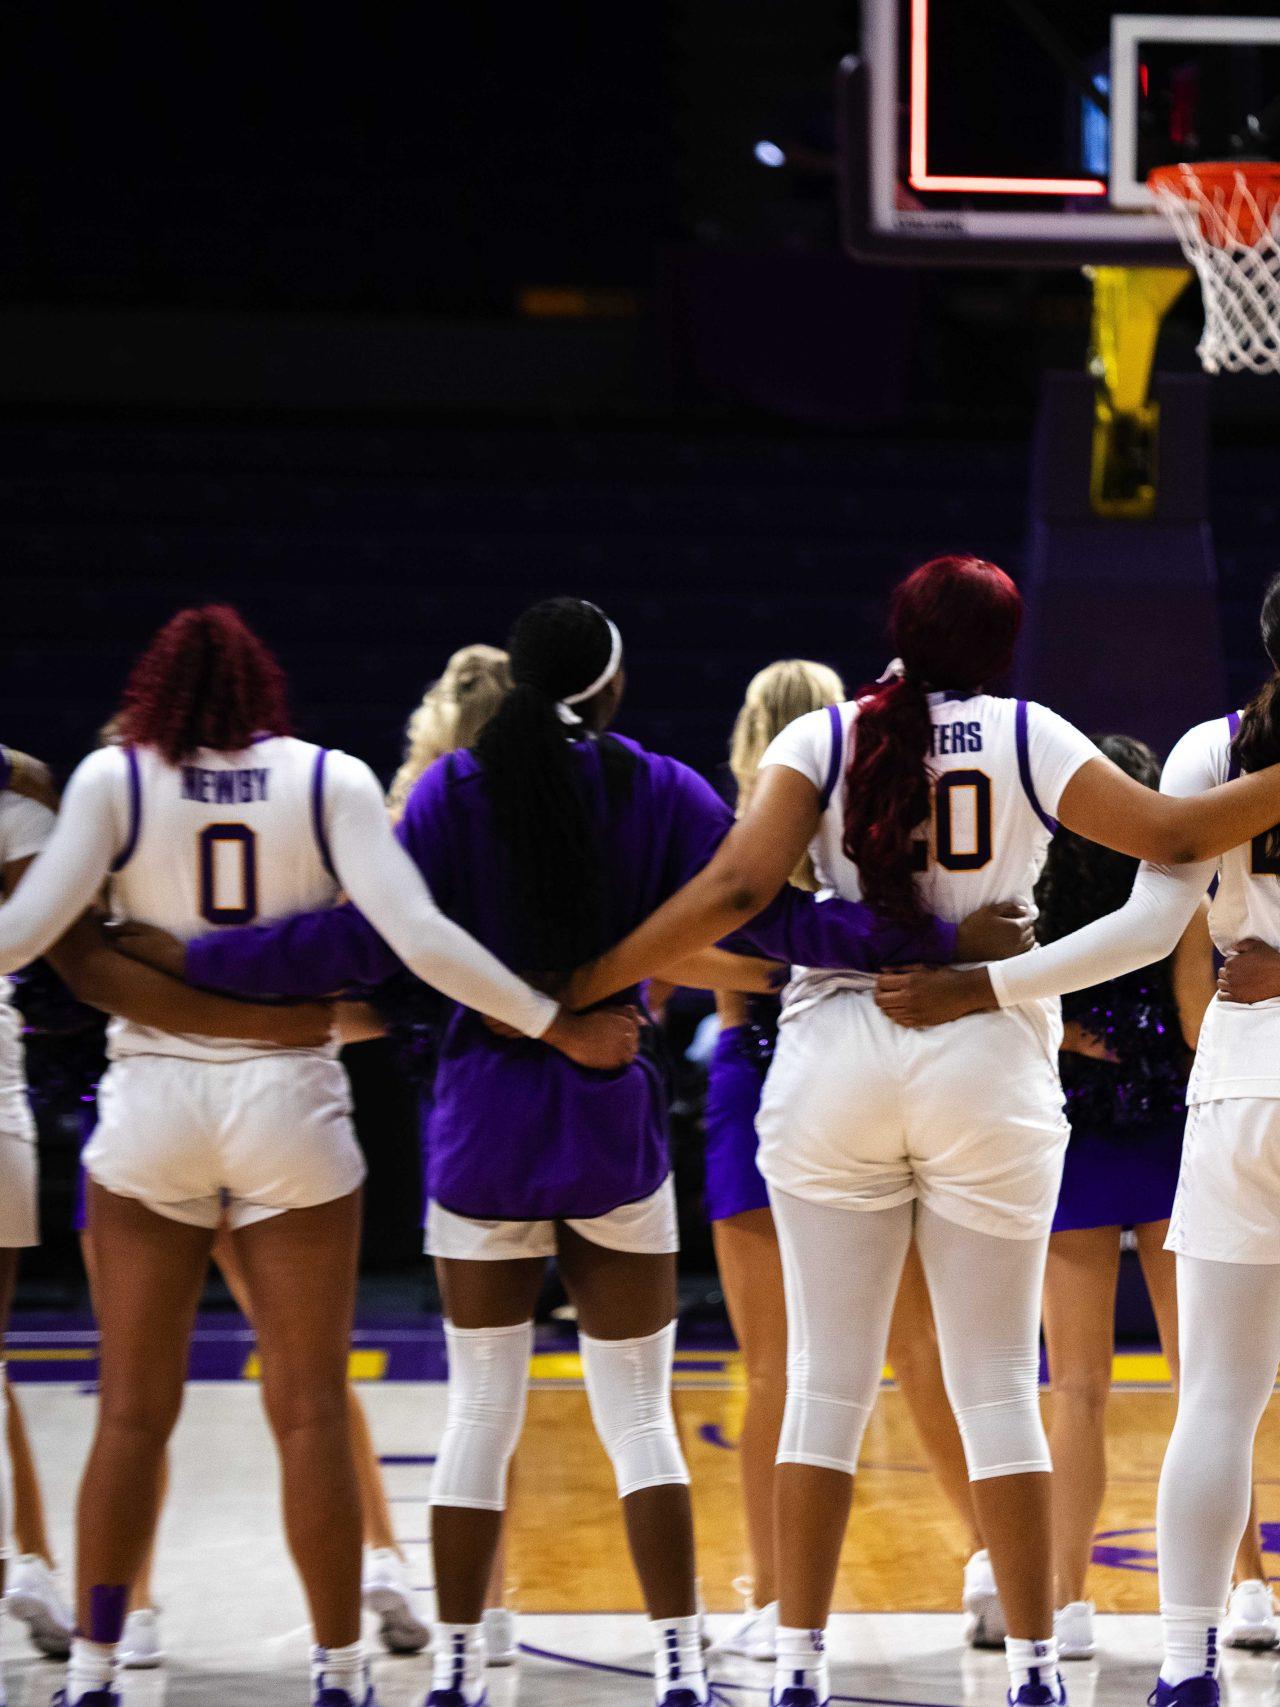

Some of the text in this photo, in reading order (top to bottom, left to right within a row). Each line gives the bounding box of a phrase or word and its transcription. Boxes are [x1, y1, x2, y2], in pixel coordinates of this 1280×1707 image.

[928, 721, 983, 757] TERS
[181, 767, 269, 803] NEWBY
[911, 769, 992, 871] 0
[199, 823, 257, 924] 0
